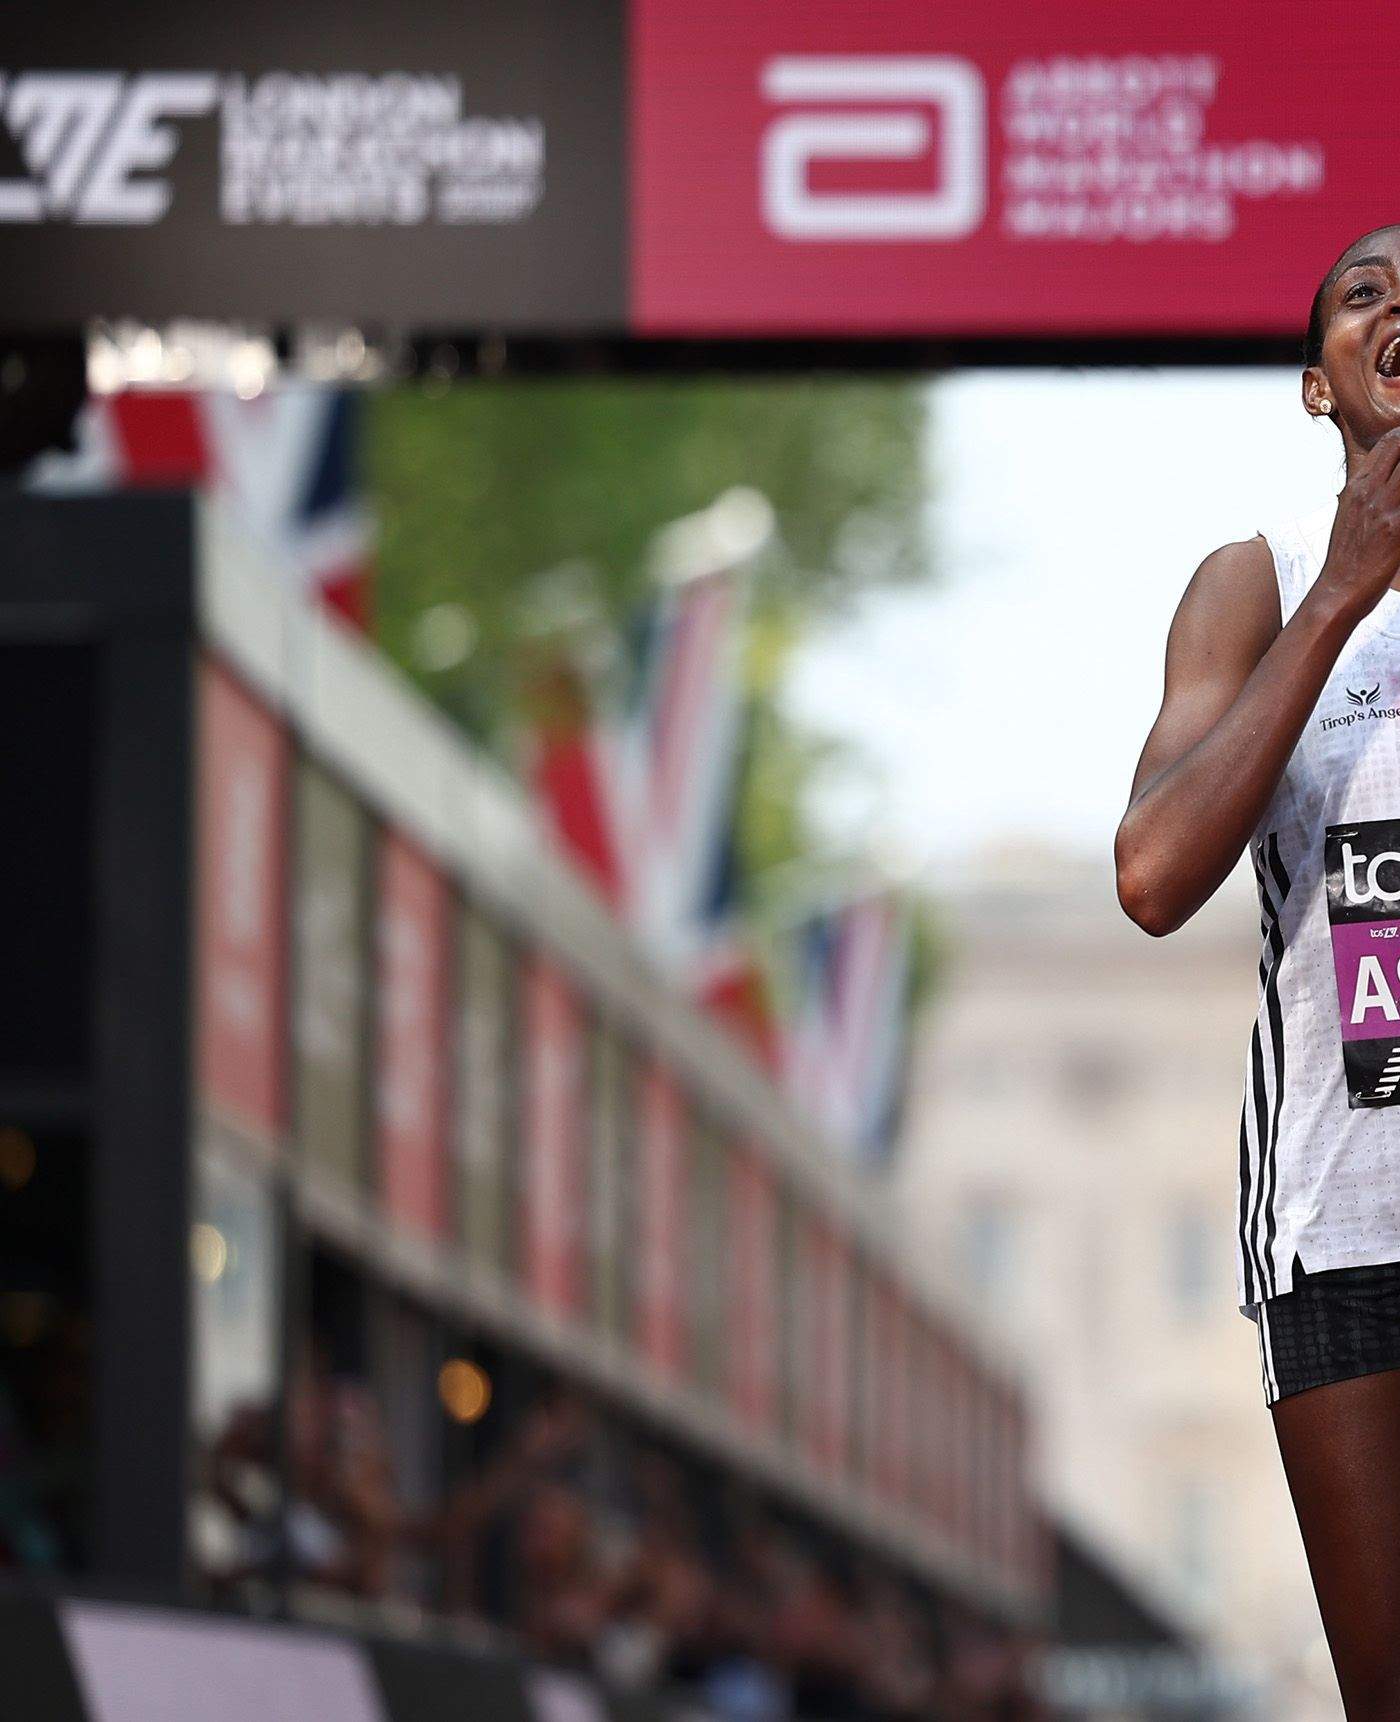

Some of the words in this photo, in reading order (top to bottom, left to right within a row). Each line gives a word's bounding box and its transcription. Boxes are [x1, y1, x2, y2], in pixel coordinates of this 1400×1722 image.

[221, 71, 461, 123] LONDON
[1003, 55, 1219, 104] ABBOTT
[221, 118, 545, 171] MARATHON
[1003, 100, 1203, 152] WORLD
[1004, 144, 1323, 196] MARATHON
[221, 172, 427, 224] EVENTS
[1004, 194, 1235, 241] MAJORS
[1320, 711, 1364, 731] Tirop's
